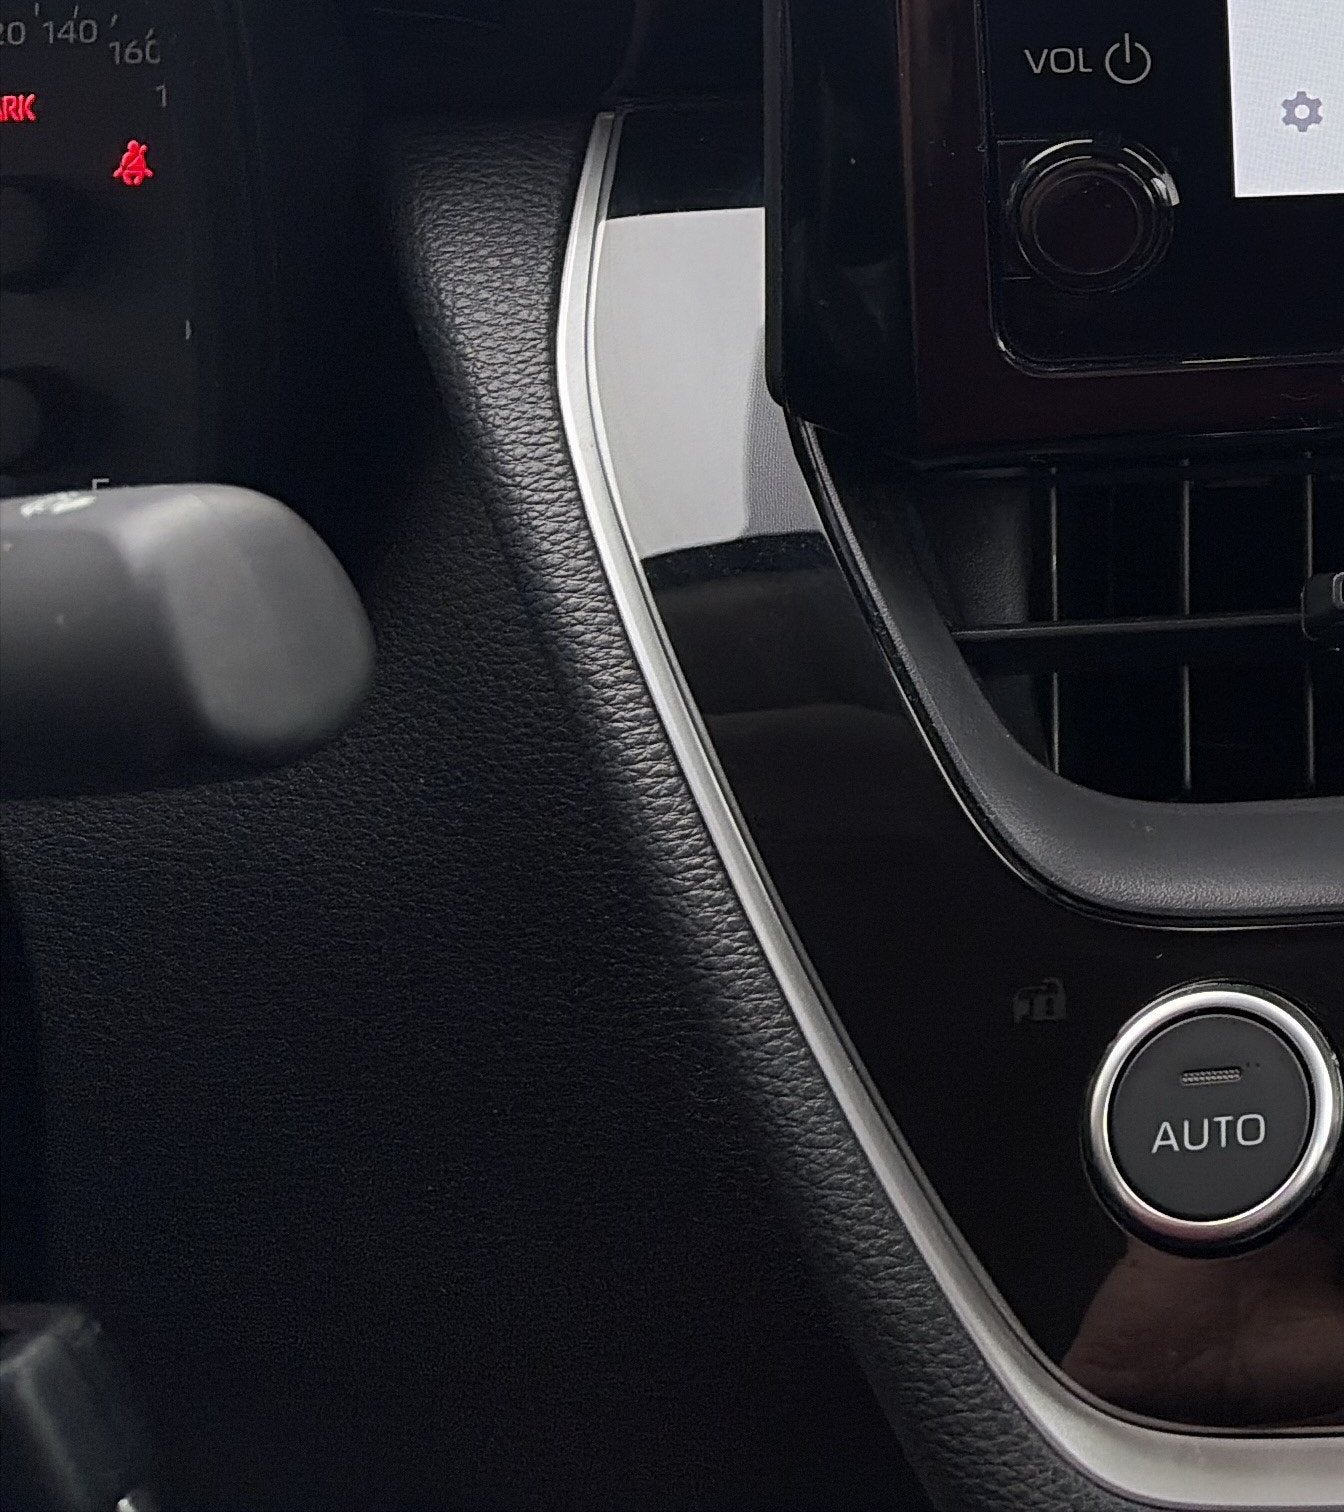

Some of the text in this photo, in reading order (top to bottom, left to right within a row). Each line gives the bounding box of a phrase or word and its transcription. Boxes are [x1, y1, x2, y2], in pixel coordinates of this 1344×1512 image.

[0, 21, 26, 46] 0
[42, 19, 98, 44] 140
[1024, 47, 1093, 74] VOL
[0, 93, 37, 122] RK
[1151, 1113, 1266, 1154] AUTO
